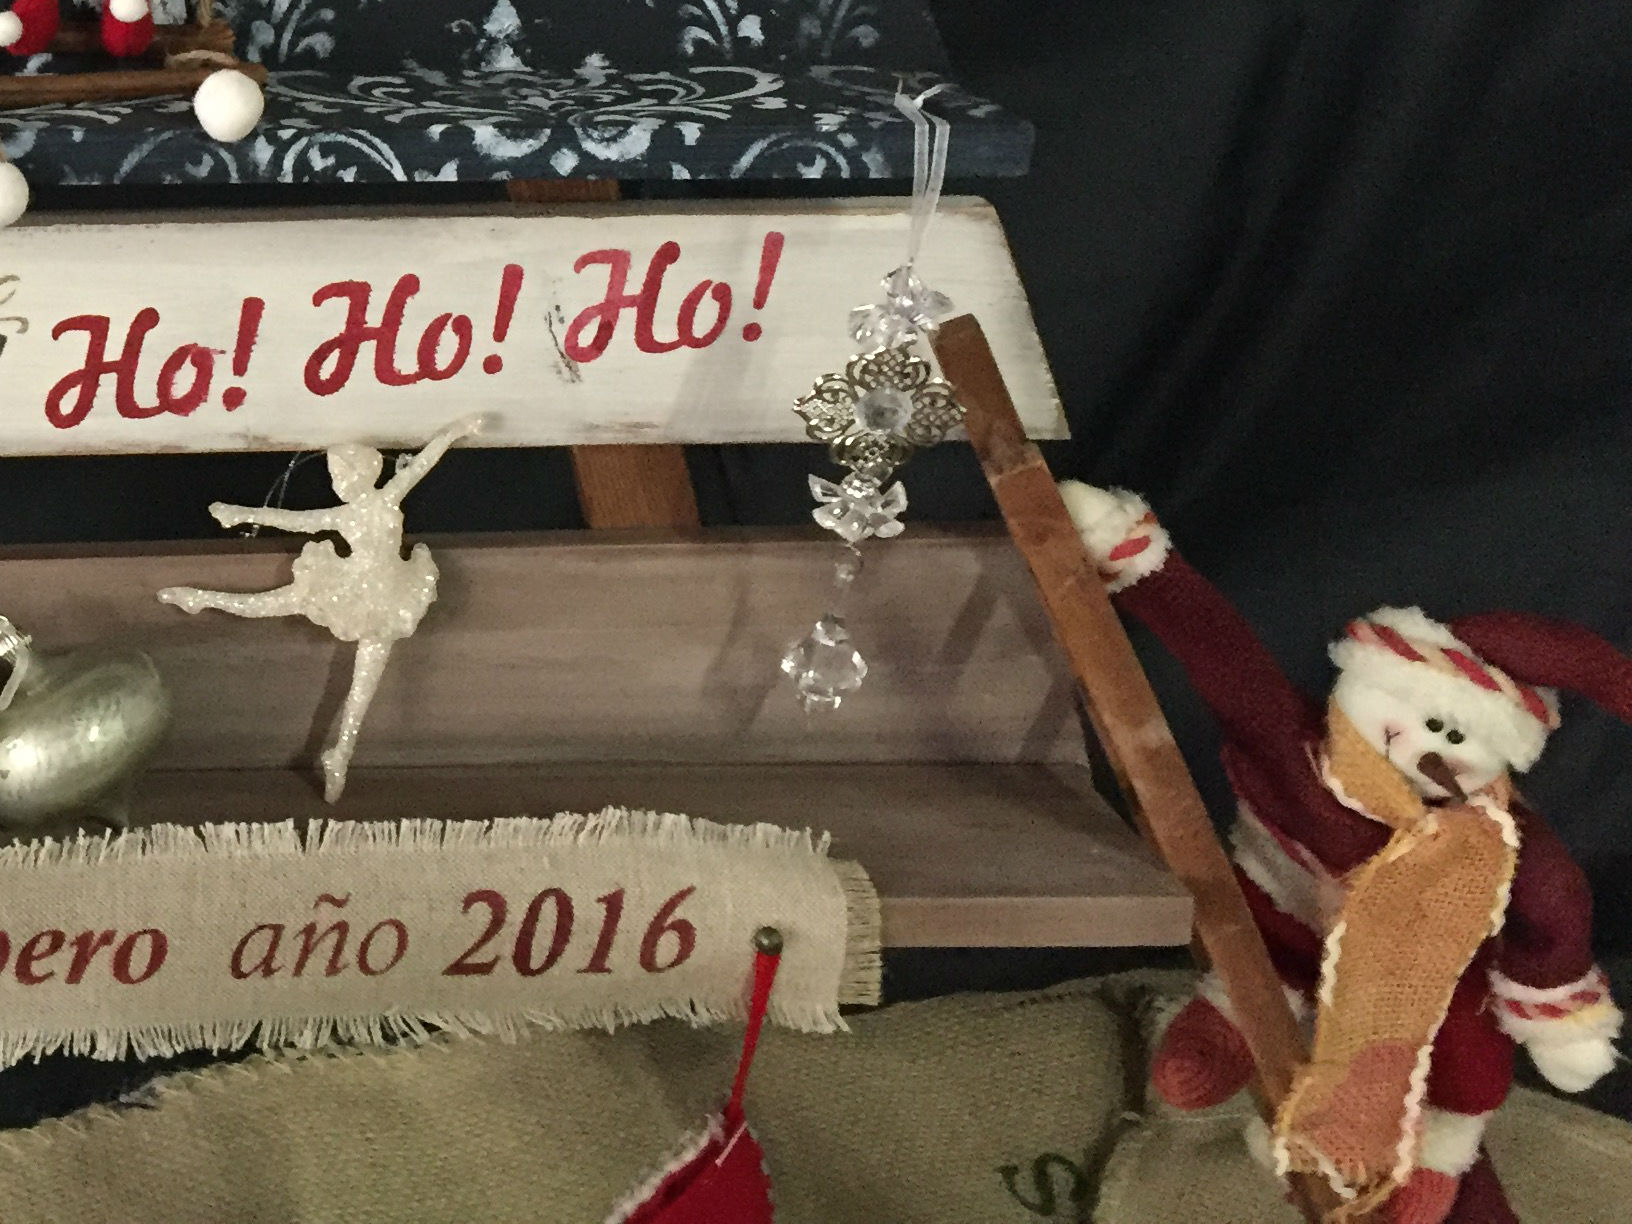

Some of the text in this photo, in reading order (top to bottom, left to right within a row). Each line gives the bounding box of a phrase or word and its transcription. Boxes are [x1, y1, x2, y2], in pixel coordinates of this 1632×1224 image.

[44, 230, 785, 429] Ho! Ho! Ho!
[229, 893, 410, 980] año
[443, 885, 699, 978] 2016
